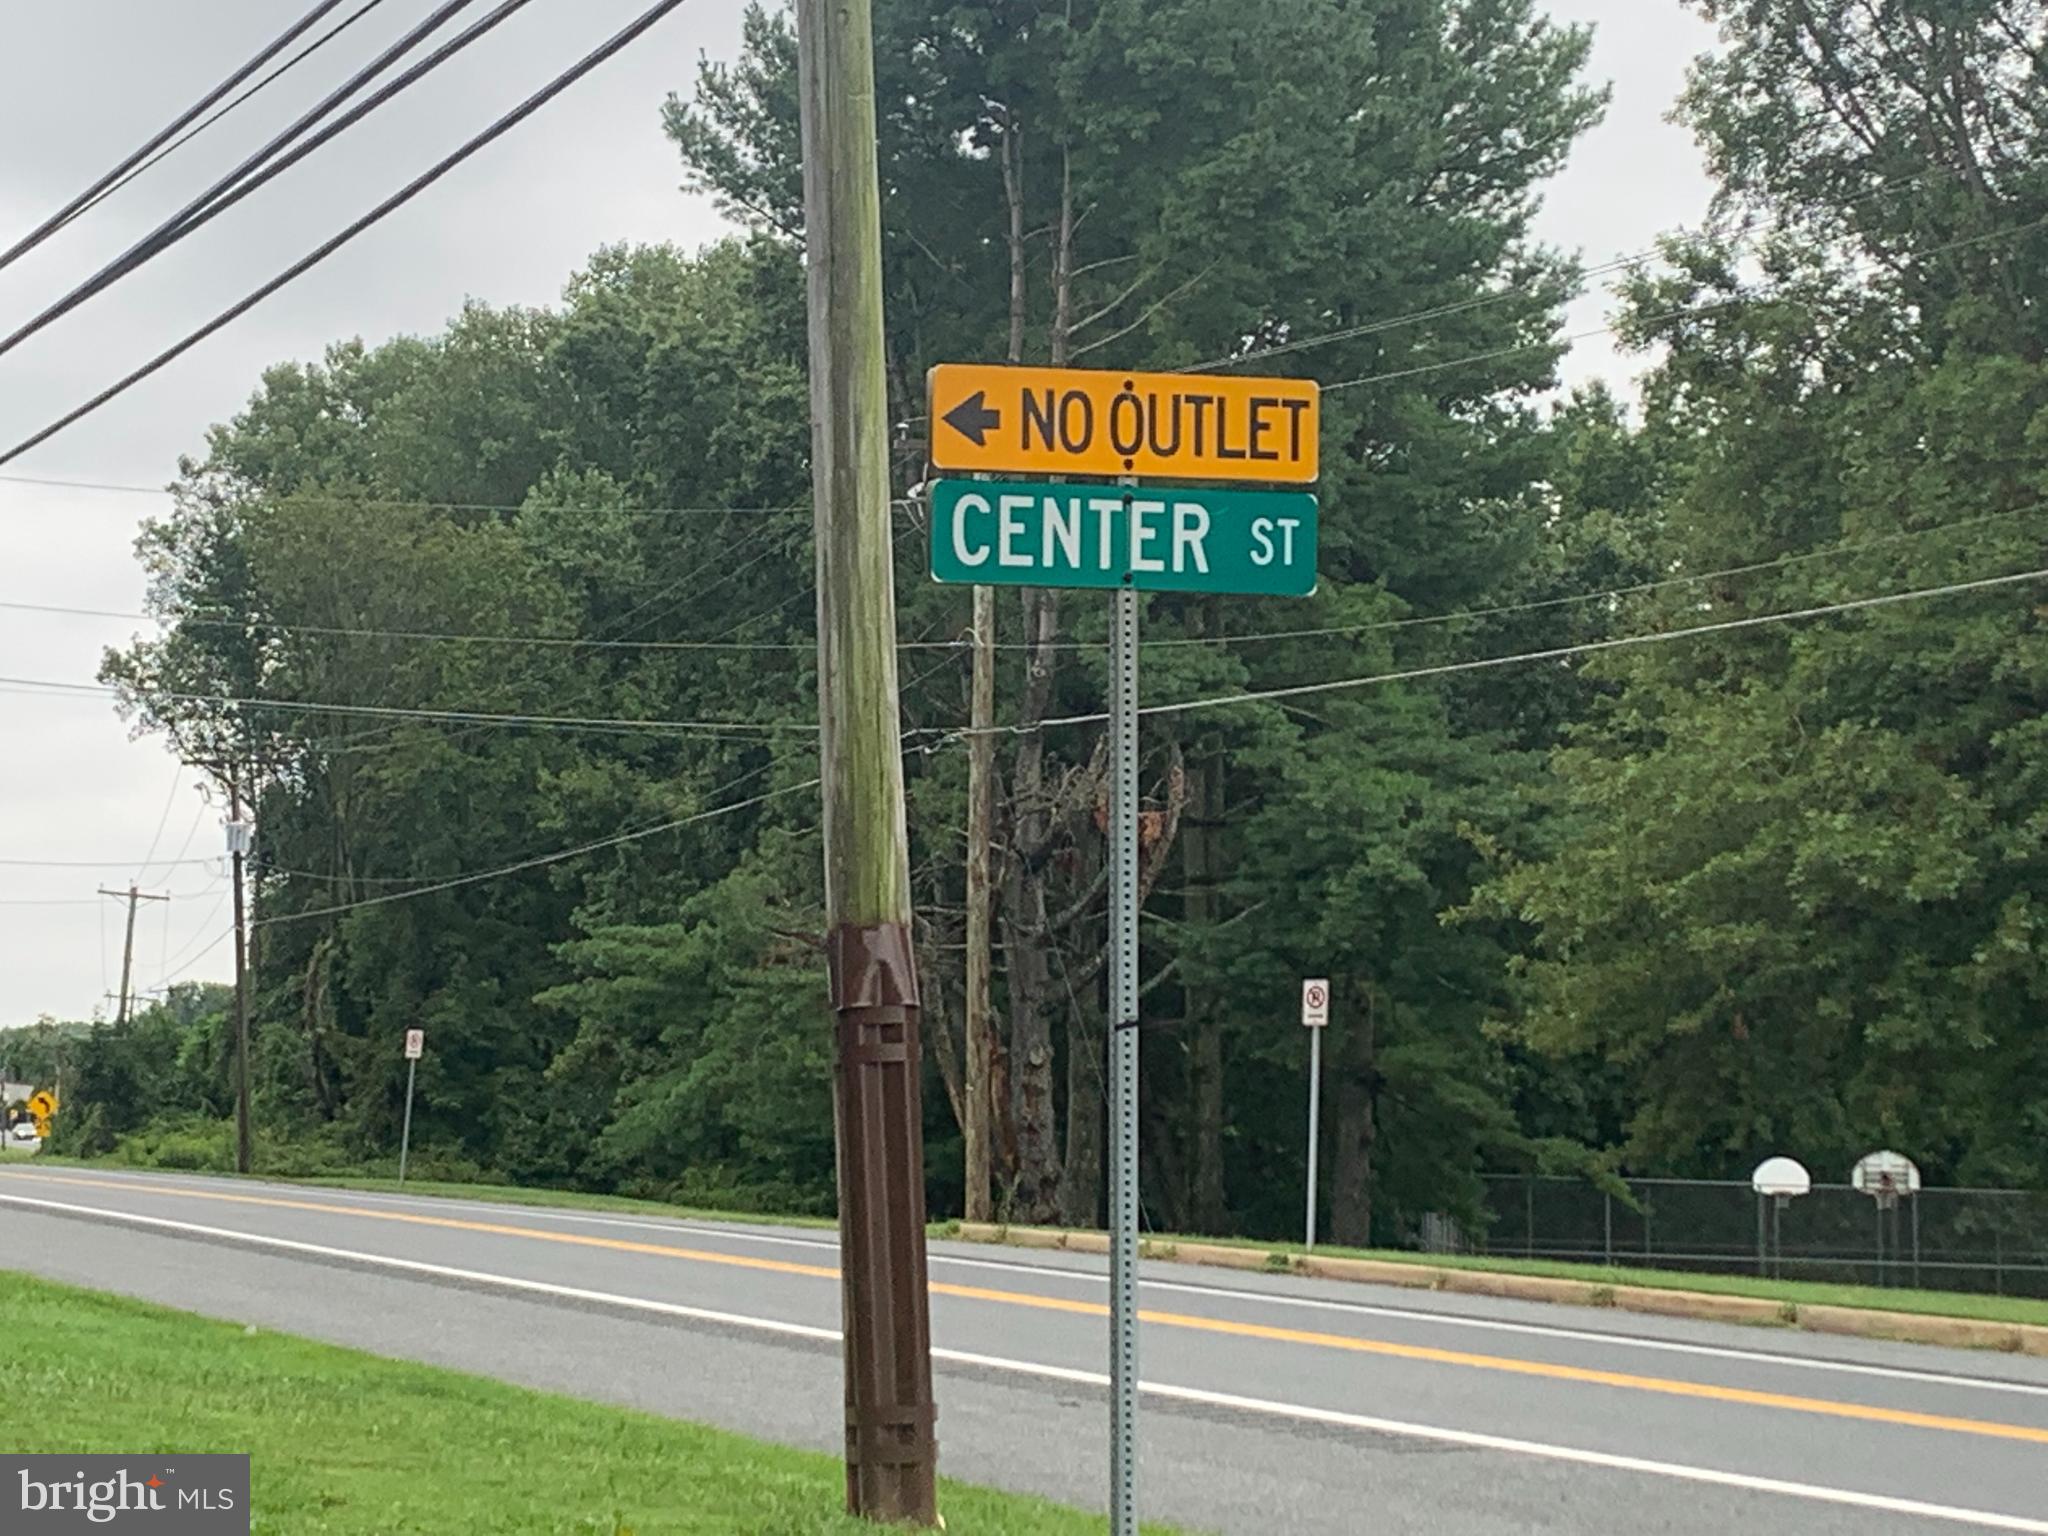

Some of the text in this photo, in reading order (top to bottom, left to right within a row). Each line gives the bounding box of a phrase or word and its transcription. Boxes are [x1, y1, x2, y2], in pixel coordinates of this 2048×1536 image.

[1021, 388, 1310, 462] NO OUTLET
[952, 493, 1300, 574] CENTER ST
